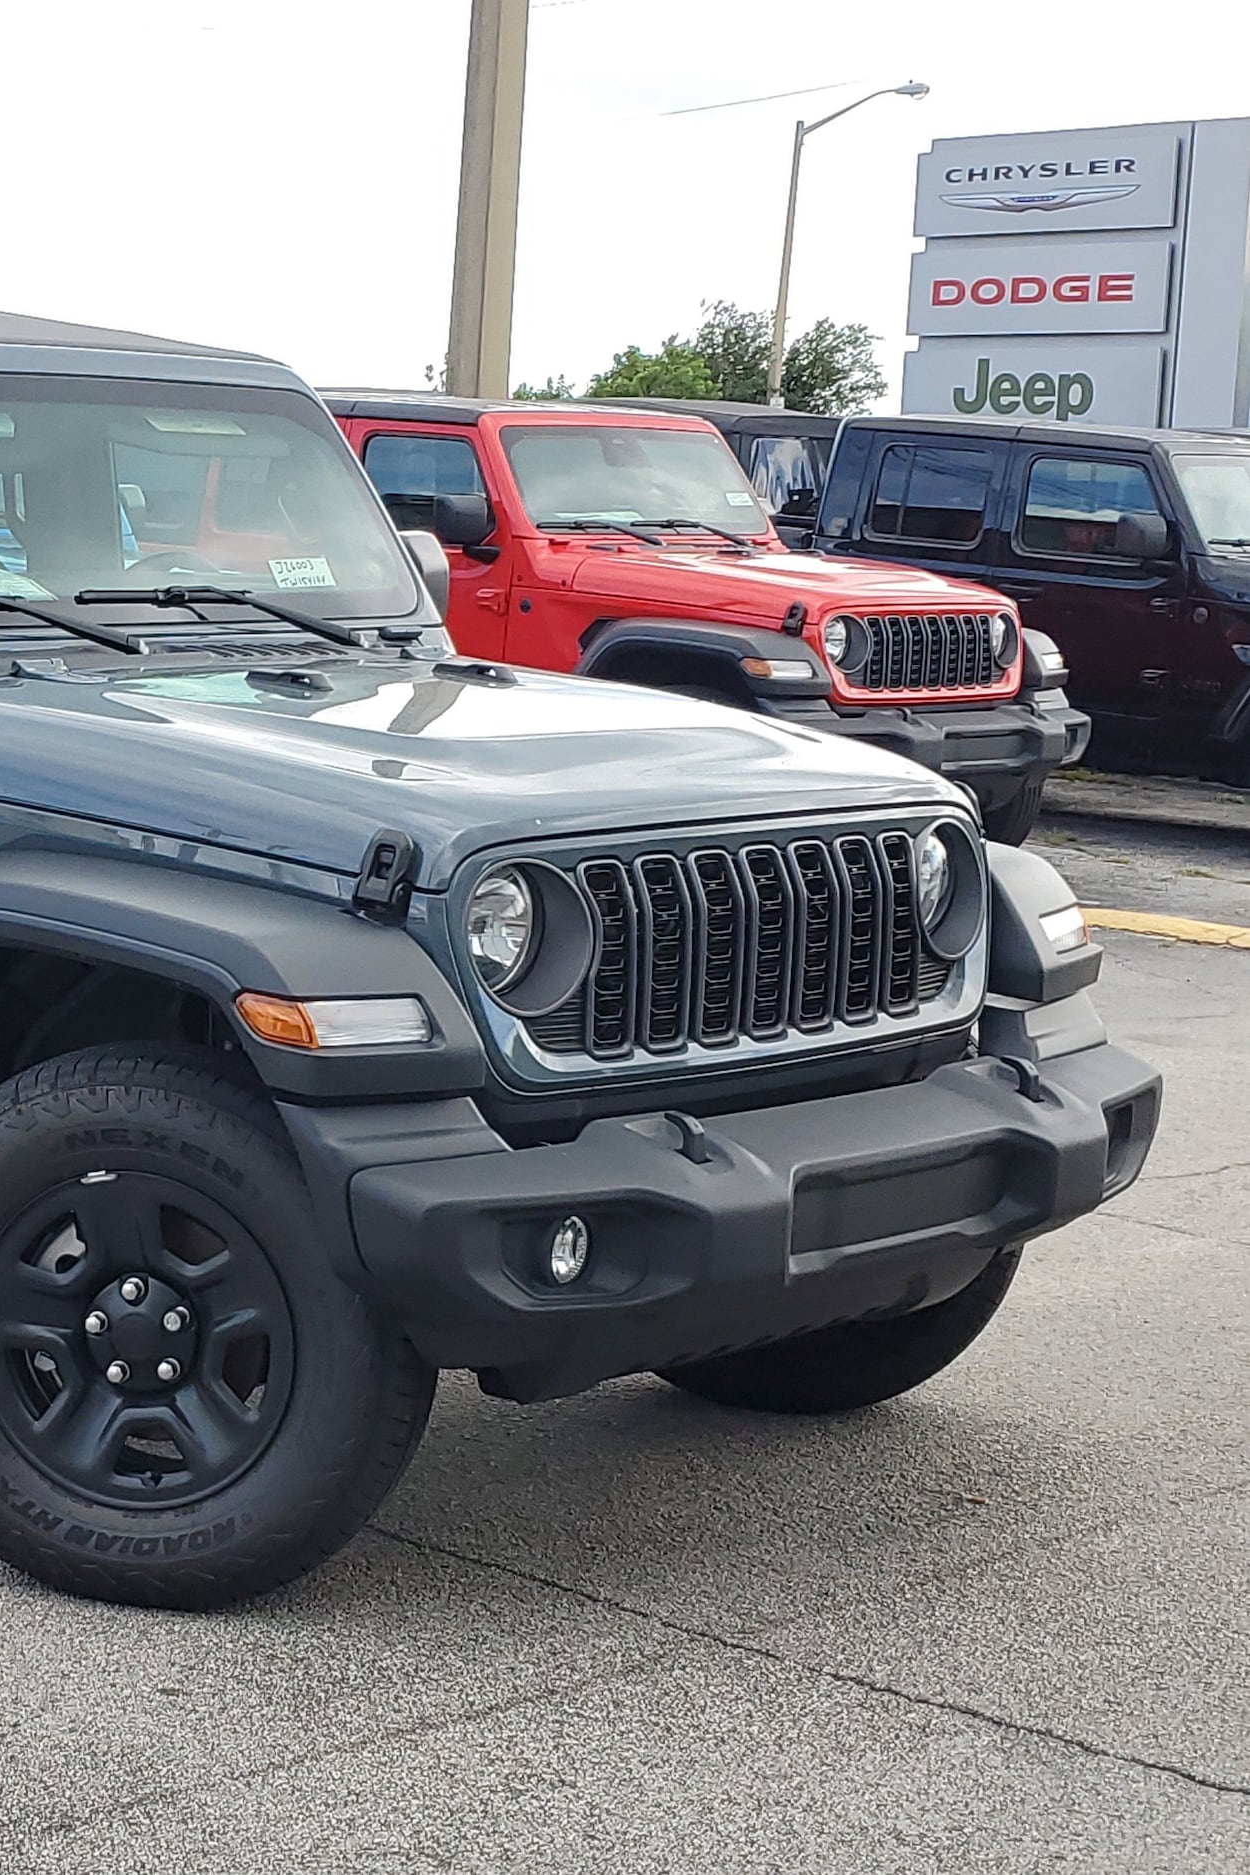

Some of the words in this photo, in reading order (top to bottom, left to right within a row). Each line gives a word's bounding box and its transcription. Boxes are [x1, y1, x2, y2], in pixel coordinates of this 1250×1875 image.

[944, 158, 1137, 184] CHRYSLER
[931, 274, 1135, 306] DODGE
[953, 358, 1094, 421] Jeep
[64, 1127, 246, 1190] NEXEN
